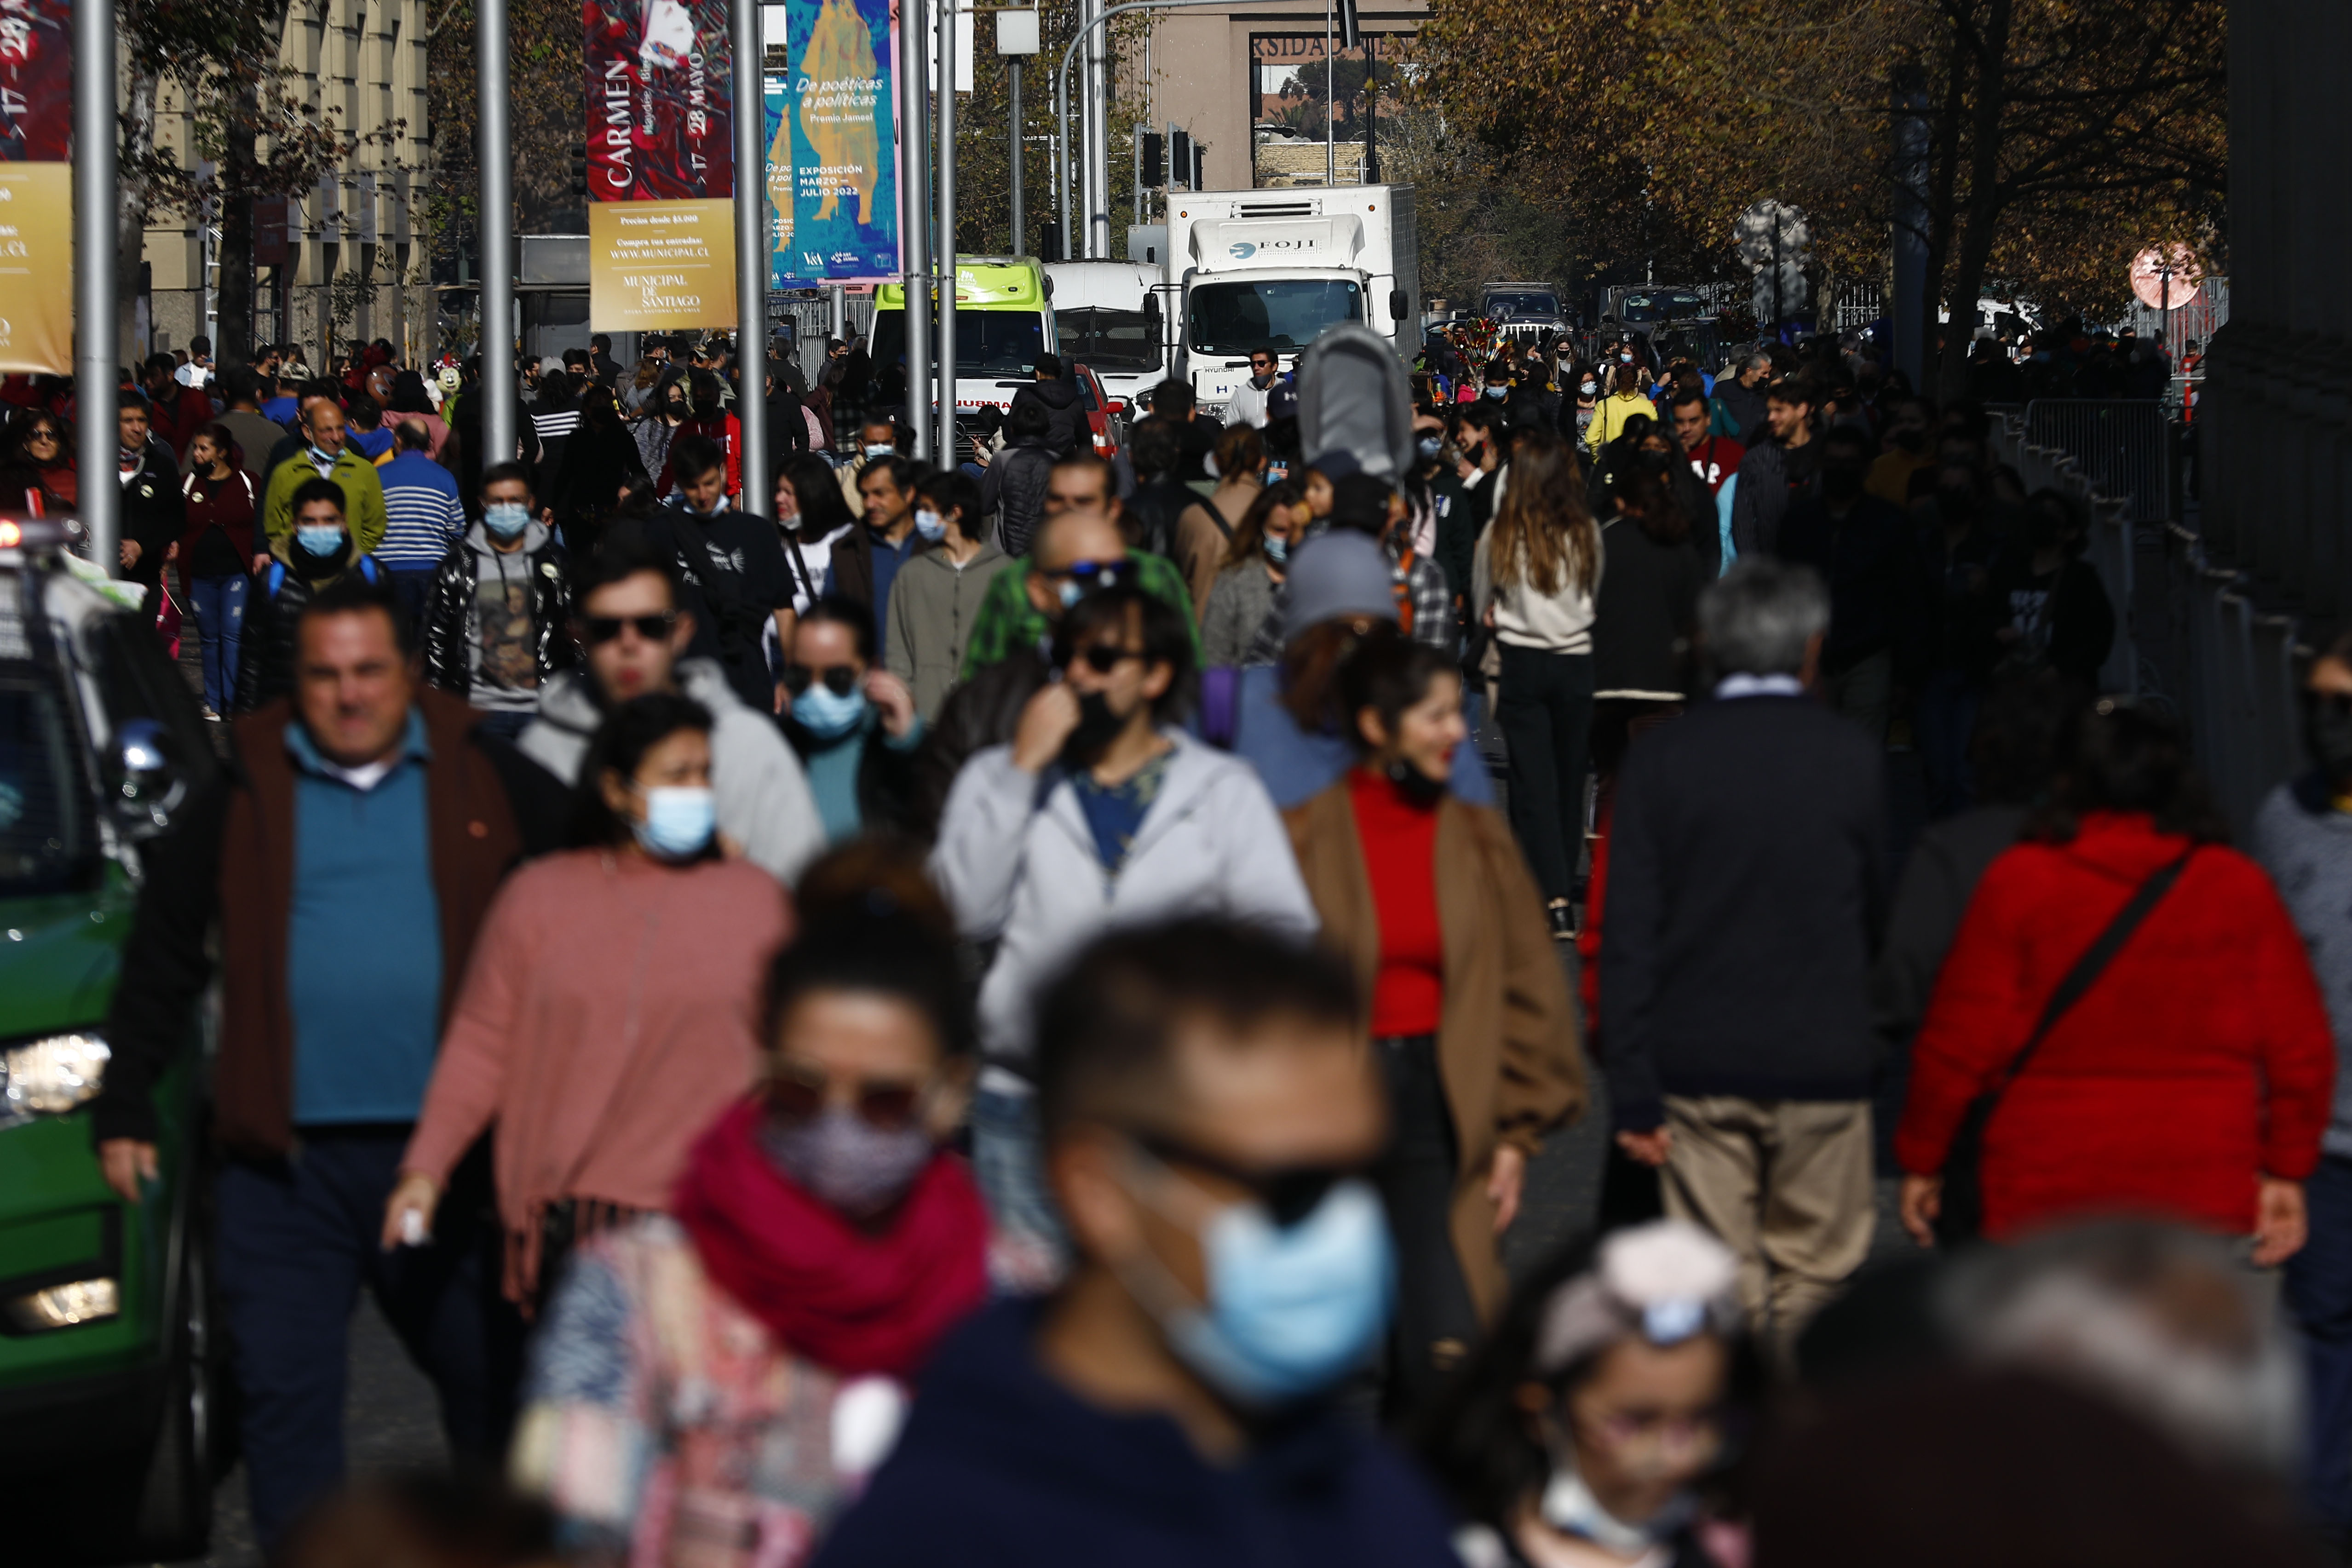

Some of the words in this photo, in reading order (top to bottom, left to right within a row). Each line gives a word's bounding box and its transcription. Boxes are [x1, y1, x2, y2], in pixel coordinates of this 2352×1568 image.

[689, 52, 705, 105] MAYO
[796, 77, 817, 92] De
[819, 76, 884, 95] poéticas
[802, 97, 812, 109] a
[813, 92, 878, 111] políticas
[604, 60, 633, 188] CARMEN
[688, 110, 707, 136] 28
[810, 114, 840, 124] Premio
[842, 113, 873, 123] Jameel
[691, 153, 707, 171] 17
[765, 163, 778, 172] De
[799, 163, 863, 175] EXPOSICIÓN
[800, 177, 837, 186] MARZO
[800, 188, 830, 197] JULIO
[833, 187, 858, 196] 2022
[620, 217, 648, 226] Precios
[650, 216, 671, 224] desde
[673, 215, 698, 224] $5.000
[616, 239, 649, 248] Compra
[666, 236, 703, 245] entradas:
[1260, 240, 1315, 249] FOJI
[610, 247, 710, 259] WWW.MUNICIPAL.CL
[623, 275, 688, 287] MUNICIPAL
[642, 286, 657, 297] DE
[642, 295, 701, 308] SANTIAGO
